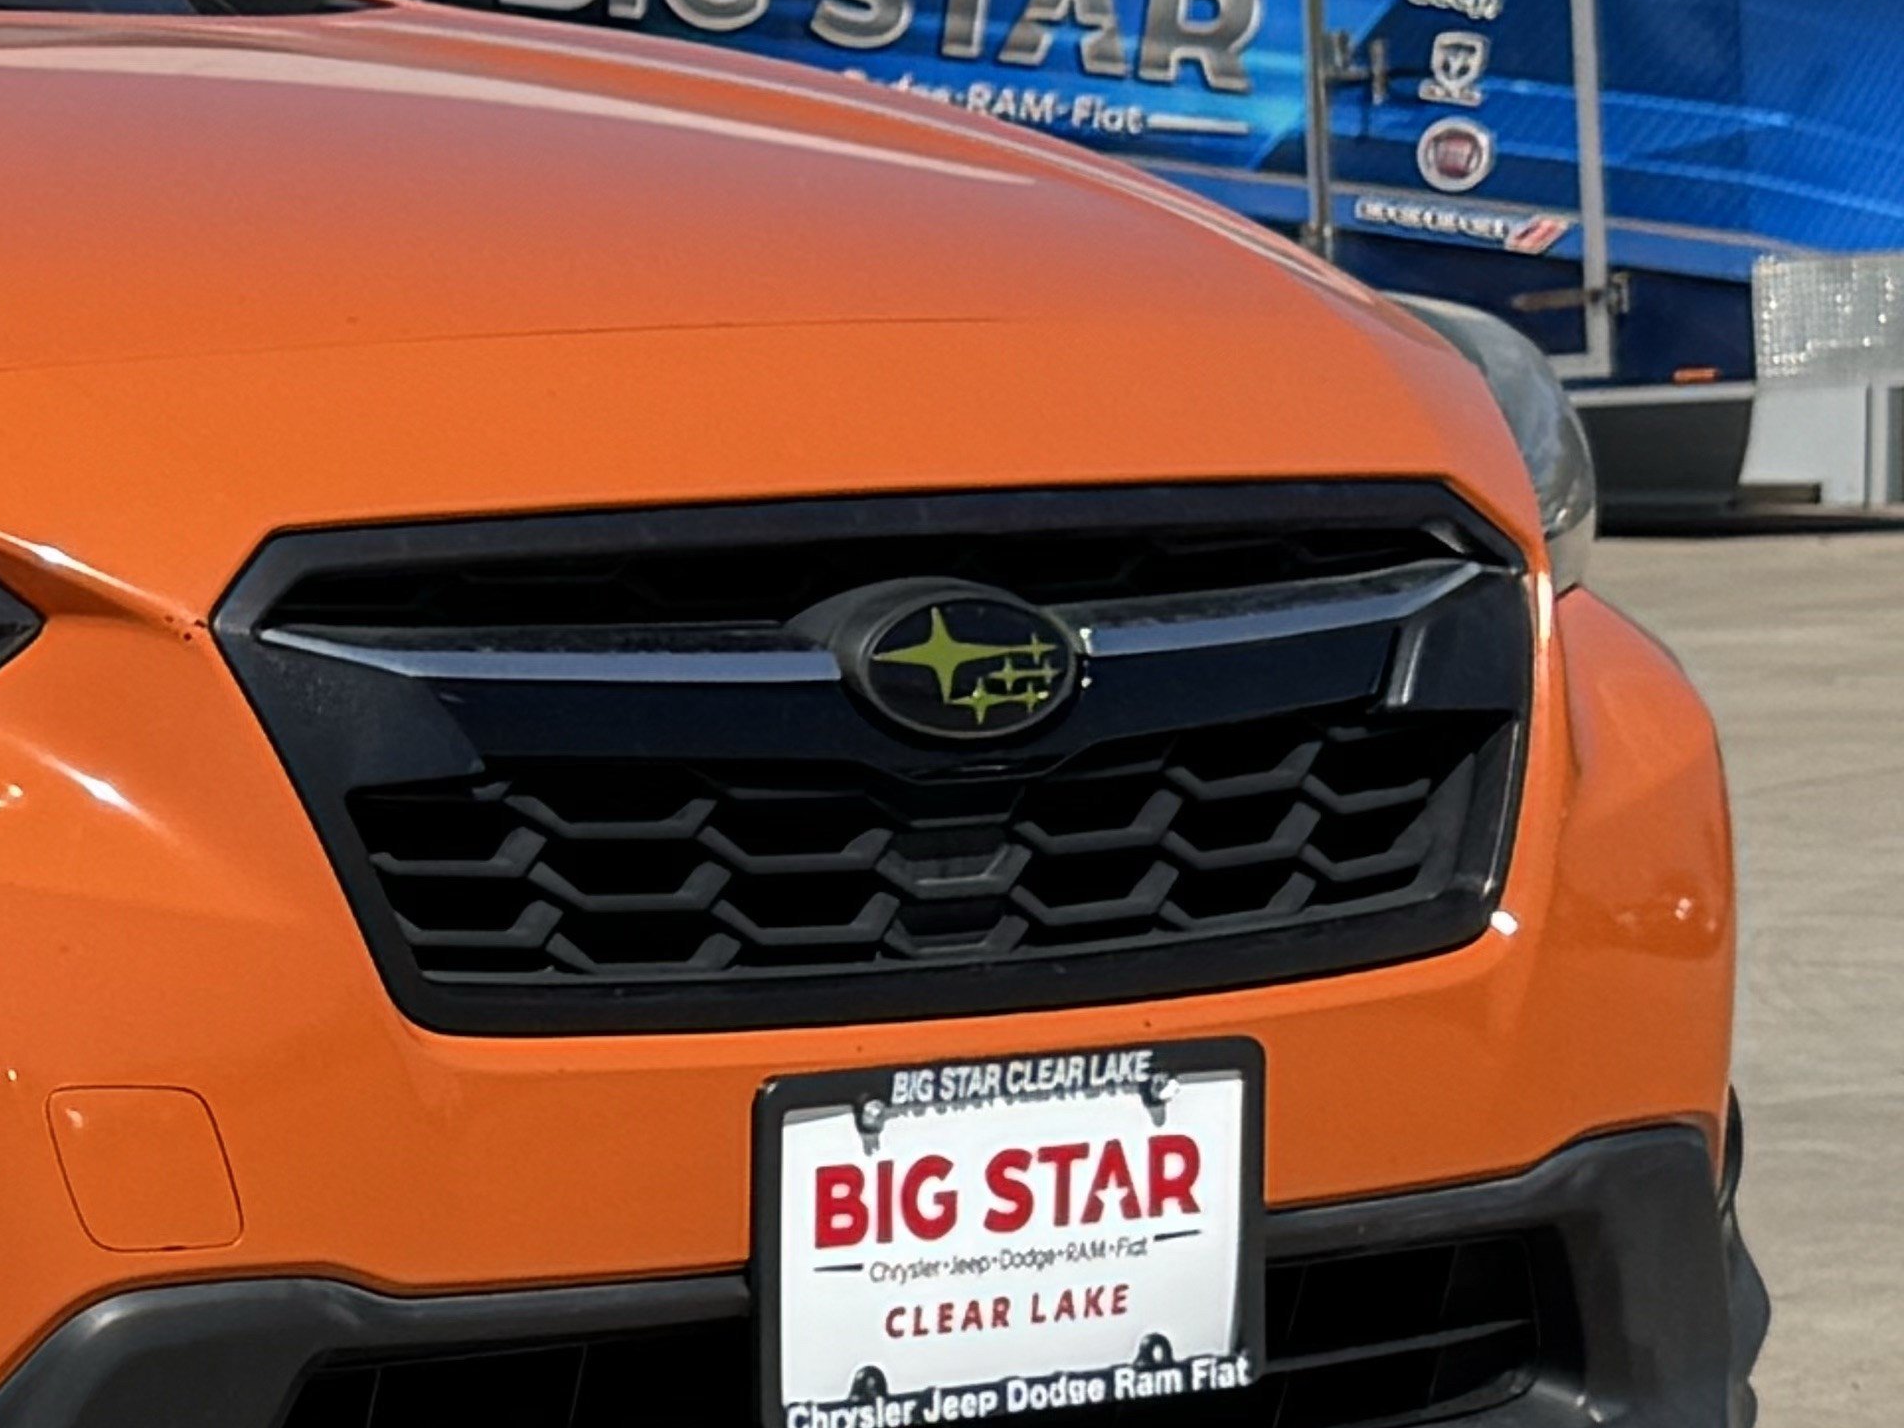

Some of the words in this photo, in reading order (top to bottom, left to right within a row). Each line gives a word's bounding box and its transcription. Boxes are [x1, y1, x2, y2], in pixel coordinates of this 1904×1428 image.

[1072, 93, 1145, 134] Fiat
[892, 1070, 935, 1104] BIG
[939, 1063, 1001, 1100] STAR
[1007, 1055, 1084, 1094] CLEAR
[1089, 1050, 1153, 1086] LAKE
[814, 1154, 958, 1249] BIG
[983, 1134, 1200, 1233] STAR
[870, 1257, 941, 1285] Chrysler
[950, 1254, 991, 1276] Jeep
[1000, 1249, 1055, 1272] Dodge
[1066, 1240, 1106, 1262] RAM
[885, 1296, 1009, 1339] CLEAR
[1031, 1283, 1130, 1323] LAKE
[923, 1388, 996, 1422] Jeep
[1007, 1374, 1105, 1413] Dodge
[1115, 1364, 1184, 1400] Ram
[1191, 1355, 1251, 1390] Fiat
